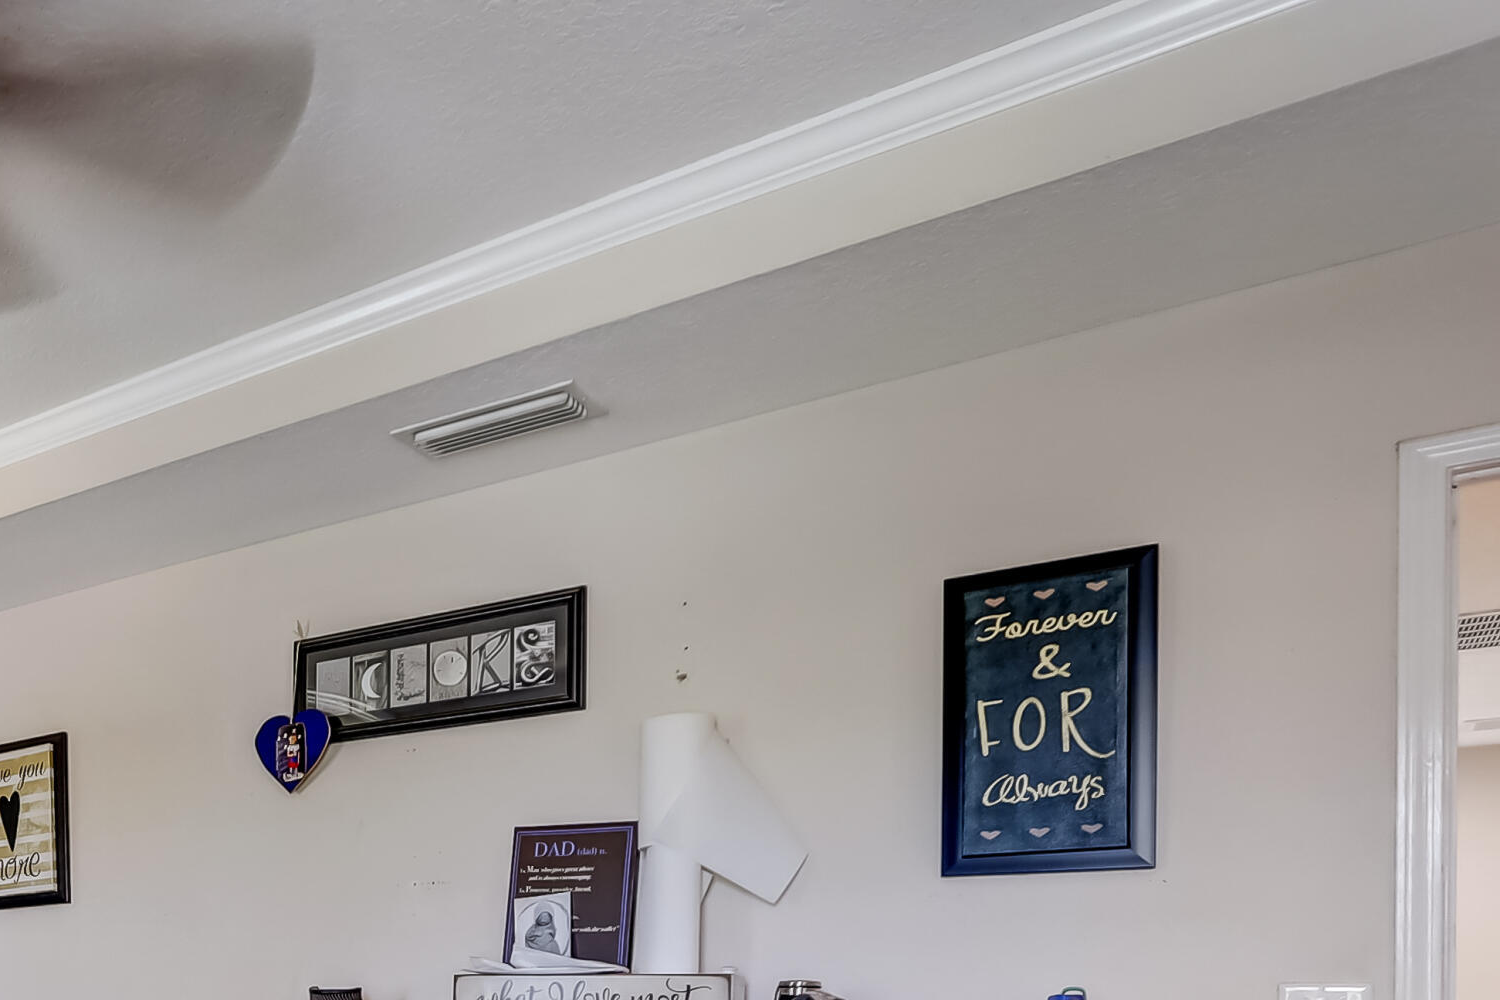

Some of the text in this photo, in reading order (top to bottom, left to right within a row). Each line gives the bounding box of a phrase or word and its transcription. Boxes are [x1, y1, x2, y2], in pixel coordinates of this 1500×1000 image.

[974, 607, 1118, 643] Forever
[1032, 643, 1071, 680] &
[976, 686, 1116, 759] FOR
[16, 760, 46, 790] you
[981, 773, 1105, 811] Always
[534, 840, 576, 858] DAD
